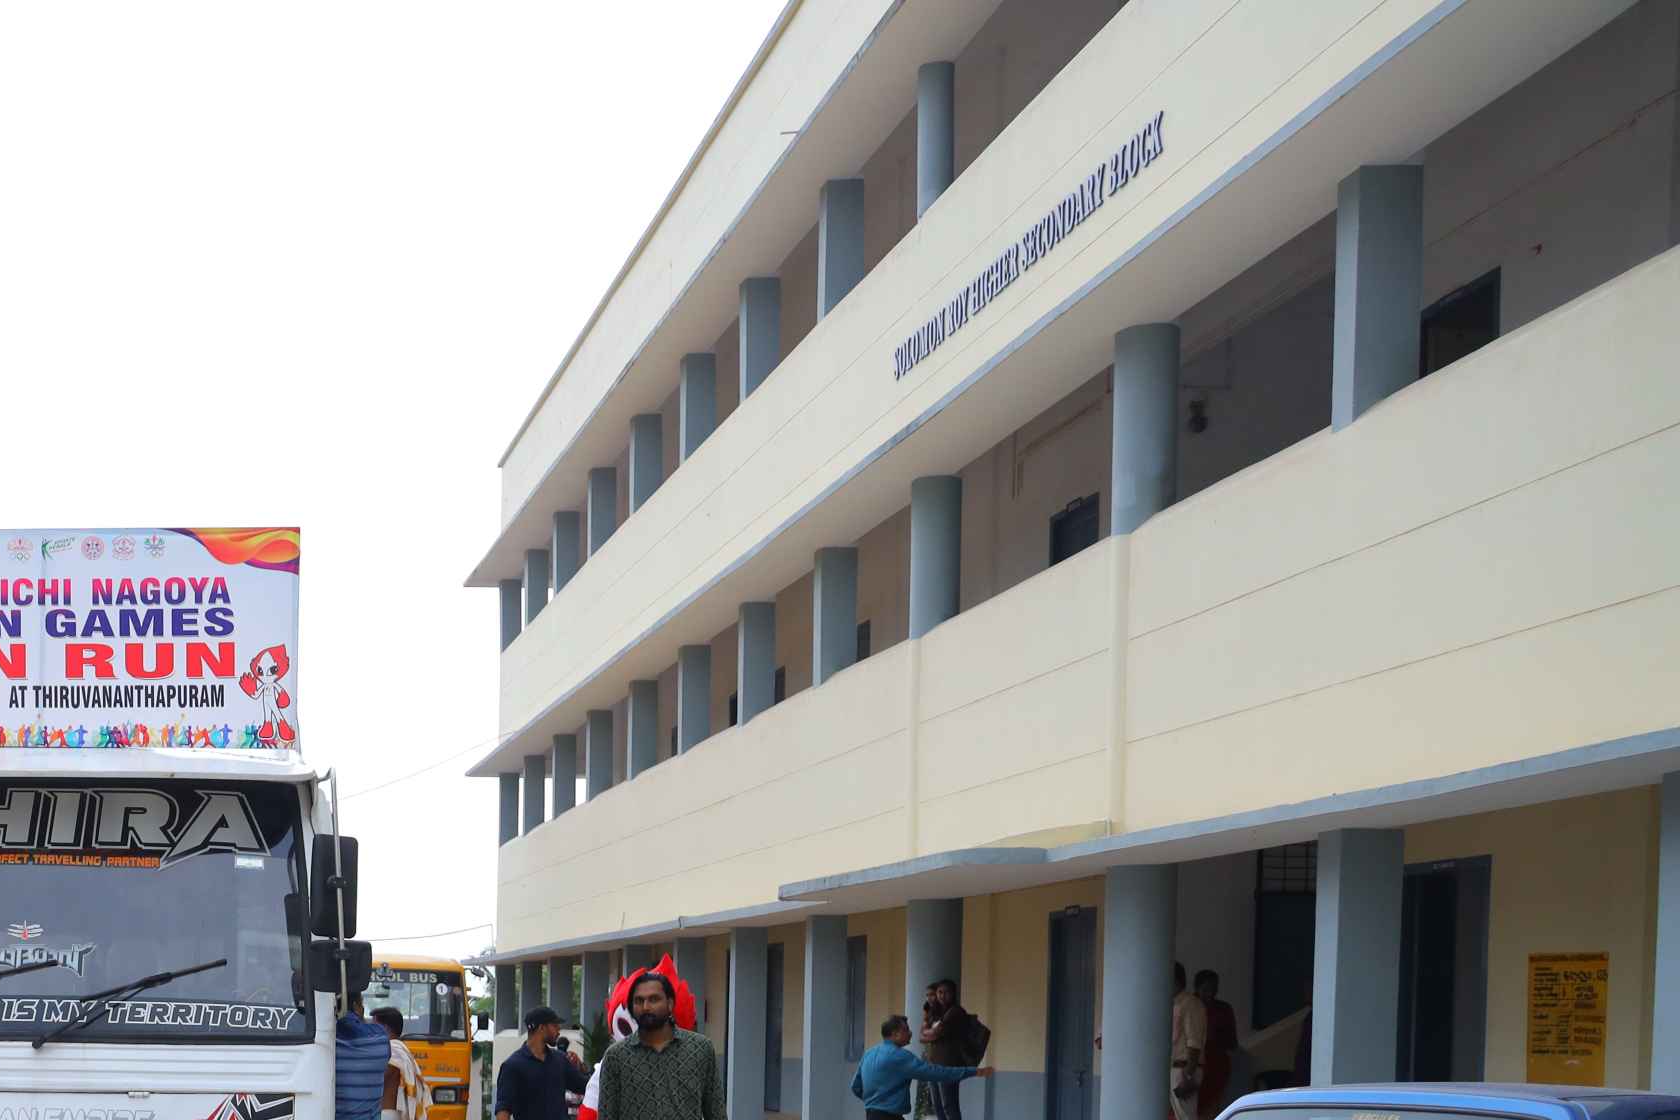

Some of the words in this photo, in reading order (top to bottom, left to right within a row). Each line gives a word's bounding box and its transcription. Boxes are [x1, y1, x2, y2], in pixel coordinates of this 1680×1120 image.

[971, 243, 1020, 316] HIGHER
[1022, 163, 1106, 272] SECONDARY
[1108, 110, 1164, 197] BLOCK
[92, 576, 231, 605] NAGOYA
[45, 607, 235, 637] GAMES
[65, 641, 239, 679] RUN
[9, 685, 28, 708] AT
[32, 684, 225, 708] THIRUVANANTHAPURAM
[106, 856, 161, 868] PARTNER
[409, 972, 438, 983] BUS
[2, 999, 40, 1022] IS
[43, 1000, 95, 1023] MY
[106, 1001, 298, 1030] TERRITORY
